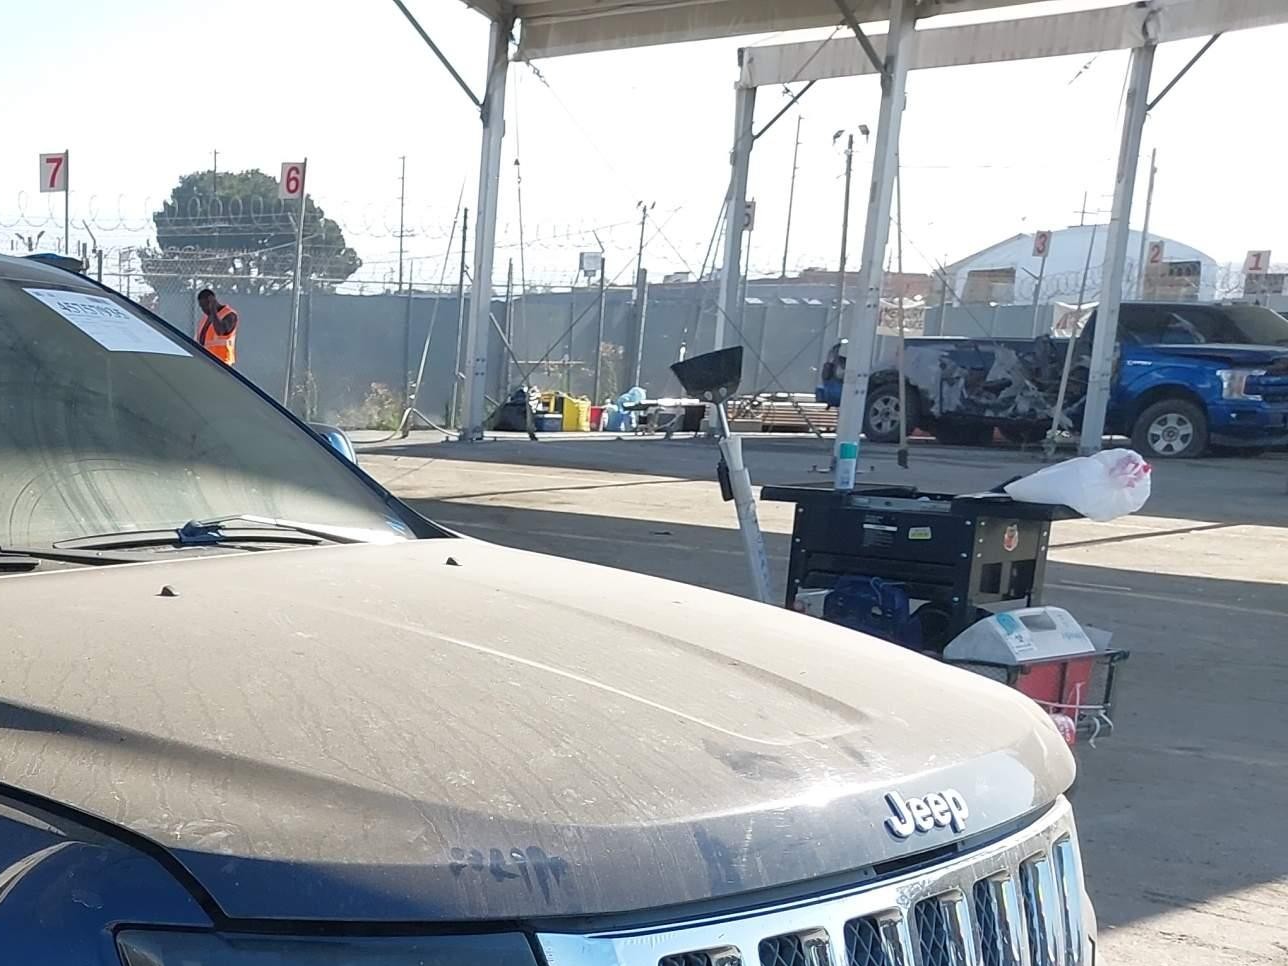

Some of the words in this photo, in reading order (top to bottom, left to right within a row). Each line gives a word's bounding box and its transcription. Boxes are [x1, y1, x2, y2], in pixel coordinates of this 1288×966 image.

[46, 158, 63, 188] 7
[287, 166, 300, 194] 6
[1036, 233, 1048, 254] 3
[1150, 244, 1161, 263] 2
[1248, 252, 1263, 271] 1
[883, 788, 969, 839] Jeep
